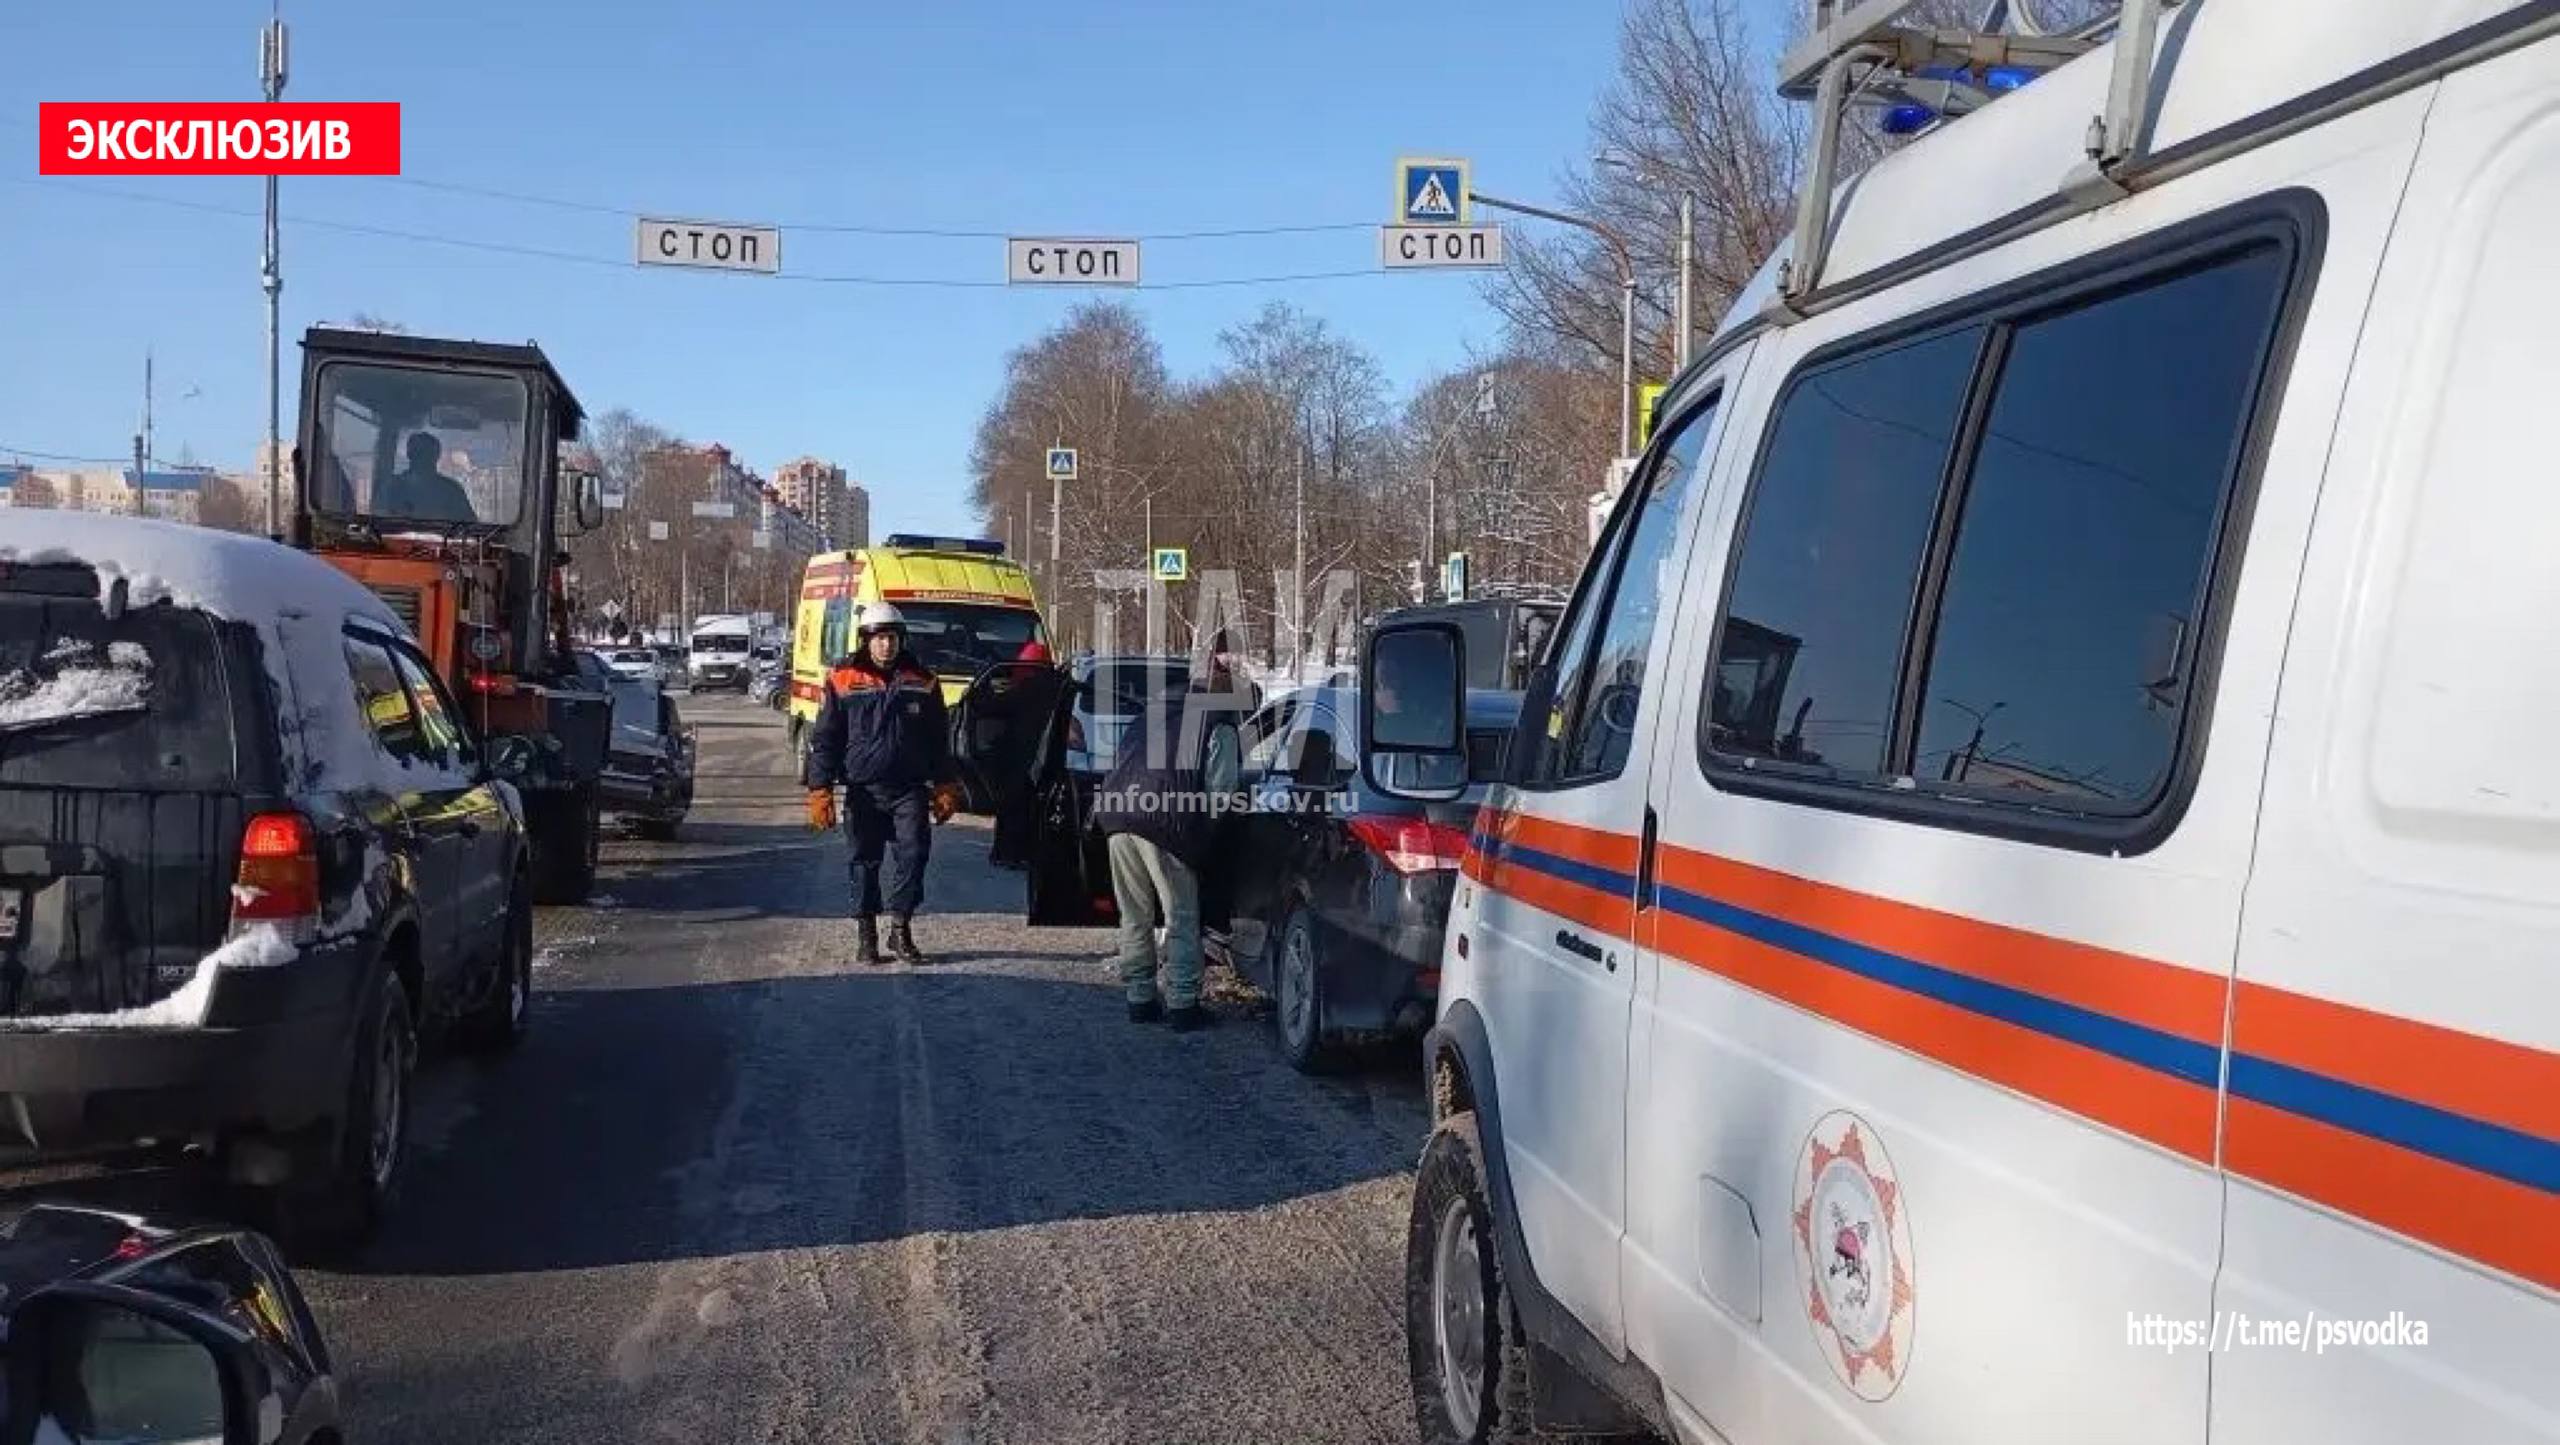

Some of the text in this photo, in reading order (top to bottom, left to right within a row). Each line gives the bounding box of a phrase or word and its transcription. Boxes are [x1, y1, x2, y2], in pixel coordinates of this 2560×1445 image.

[660, 229, 757, 262] СТОП
[1400, 233, 1484, 259] СТОП
[1027, 247, 1120, 277] СТОП
